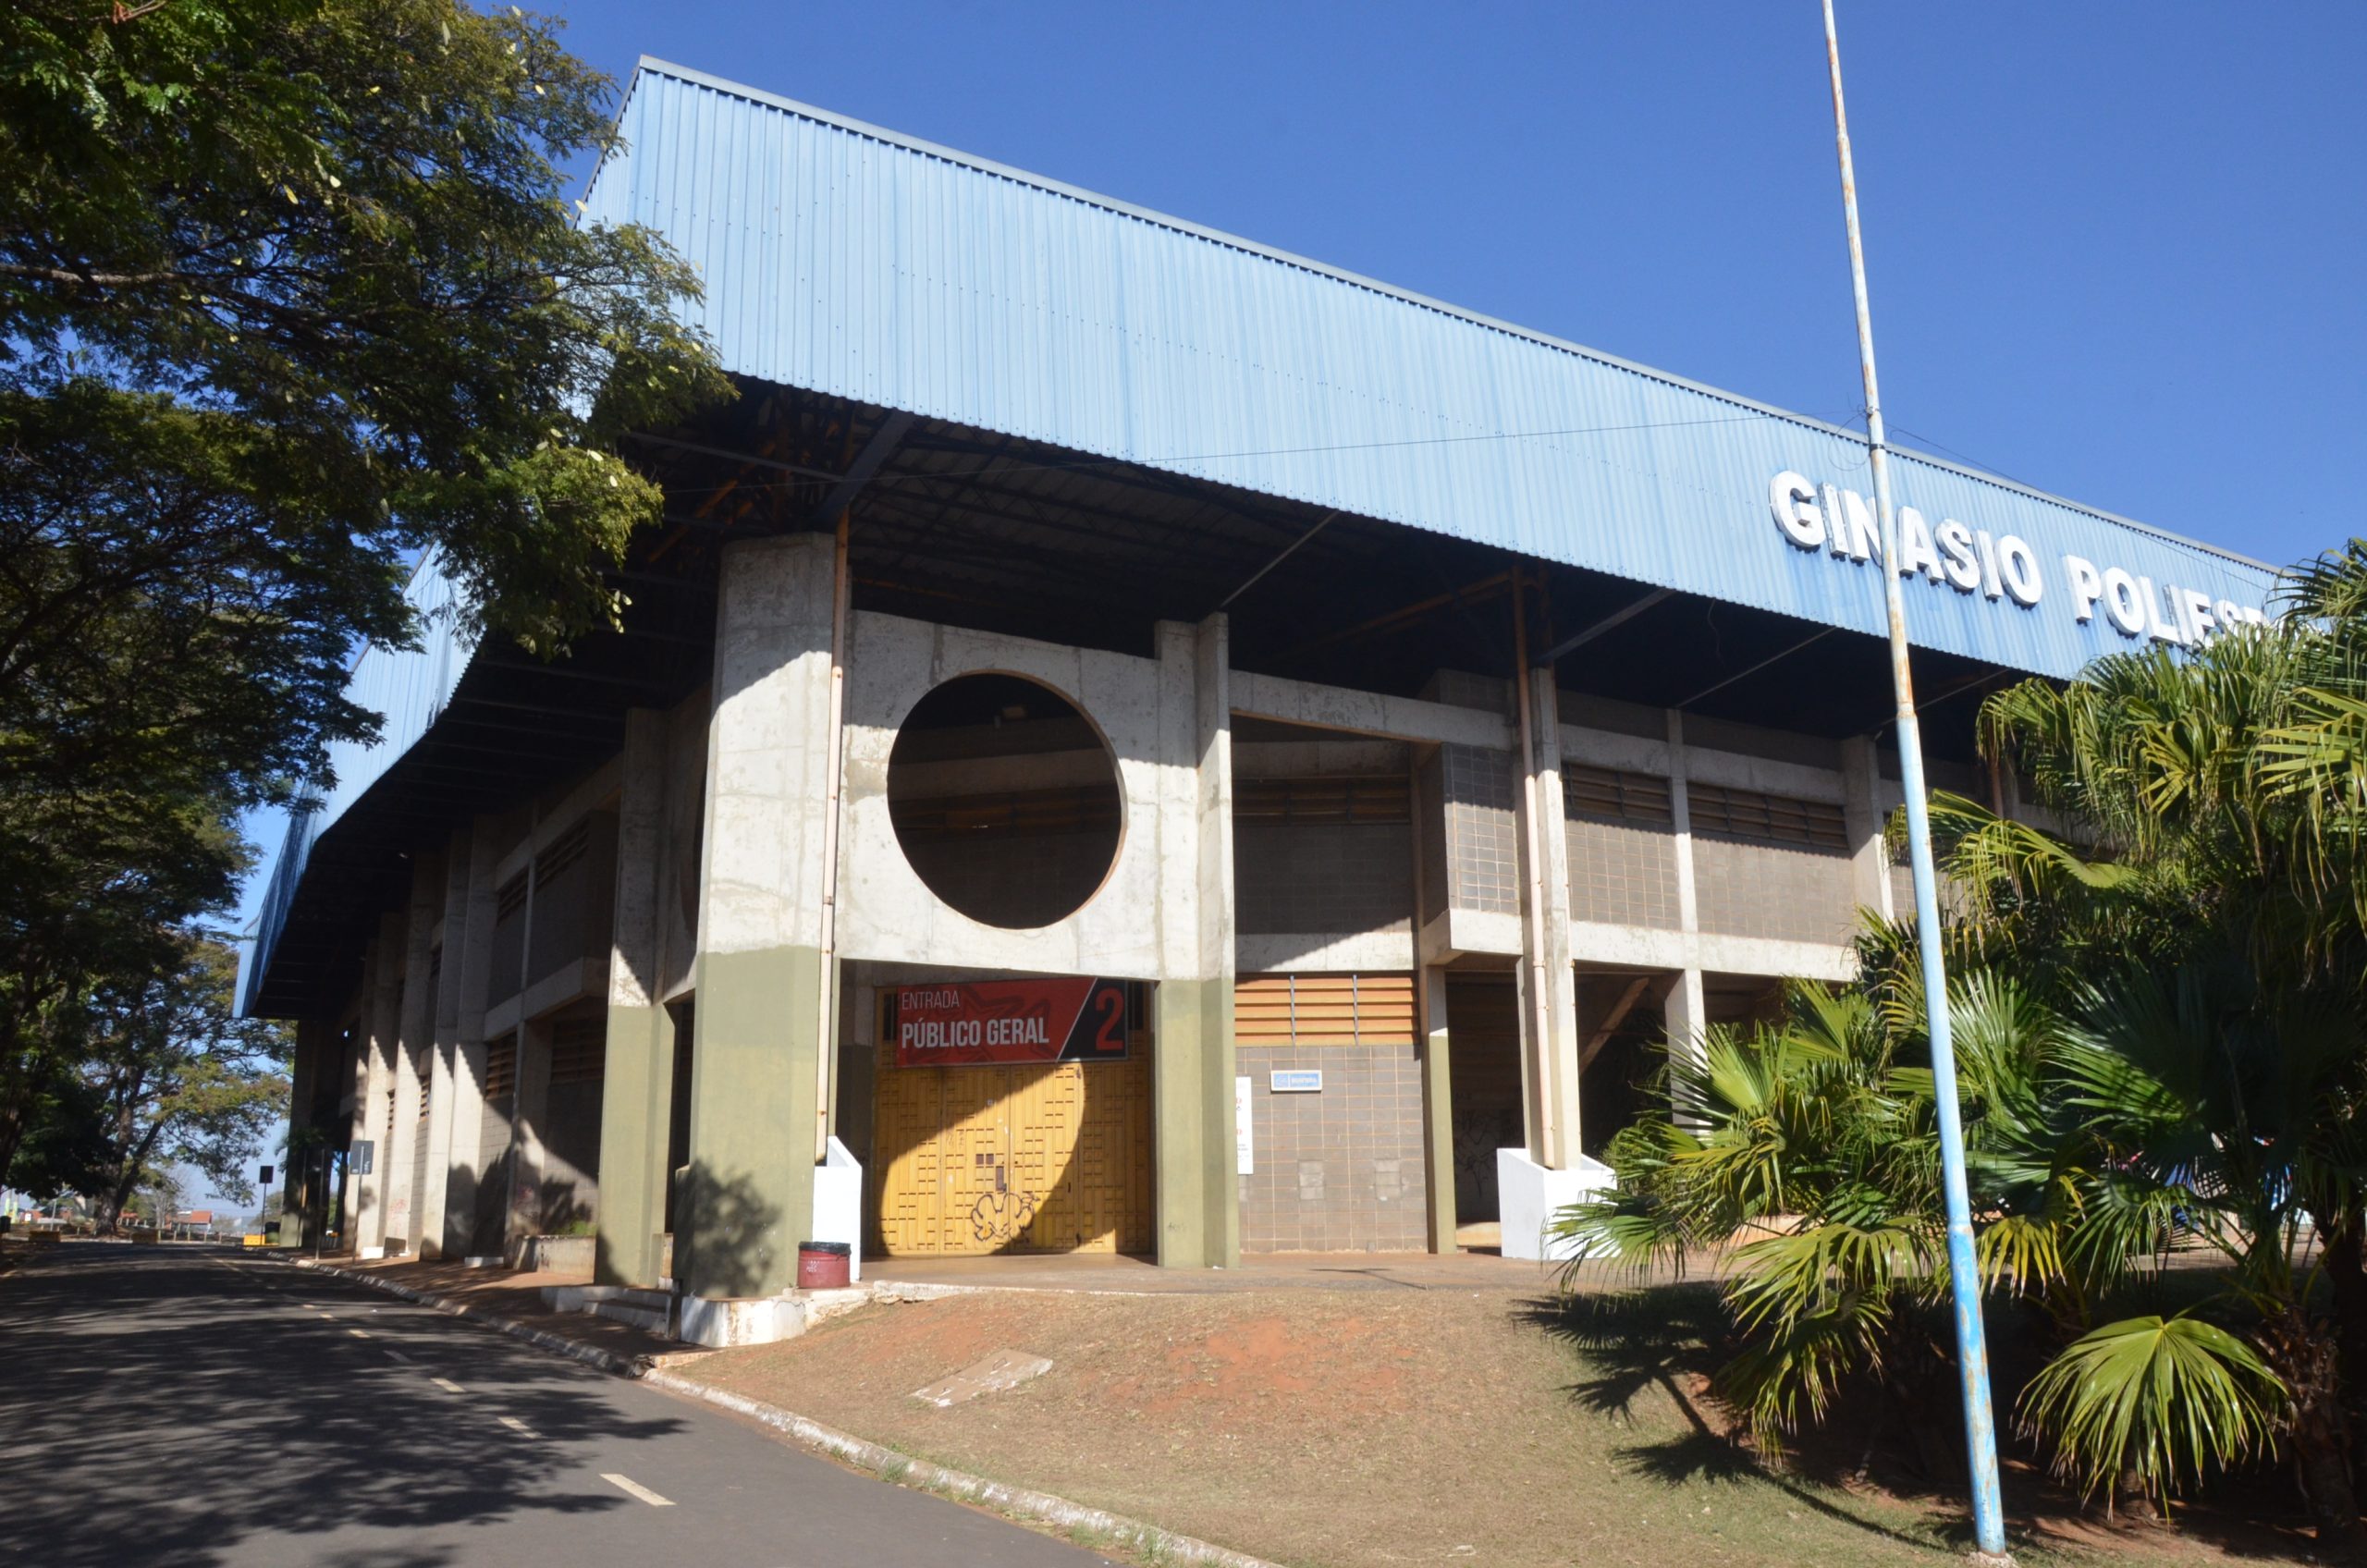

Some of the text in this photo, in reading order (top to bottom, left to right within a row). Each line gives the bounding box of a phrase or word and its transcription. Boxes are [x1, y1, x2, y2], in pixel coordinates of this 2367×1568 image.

[1769, 470, 2042, 606] GINASIO
[901, 990, 960, 1011] ENTRADA
[1095, 987, 1124, 1051] 2
[901, 1017, 1049, 1048] PÚBLICO GERAL
